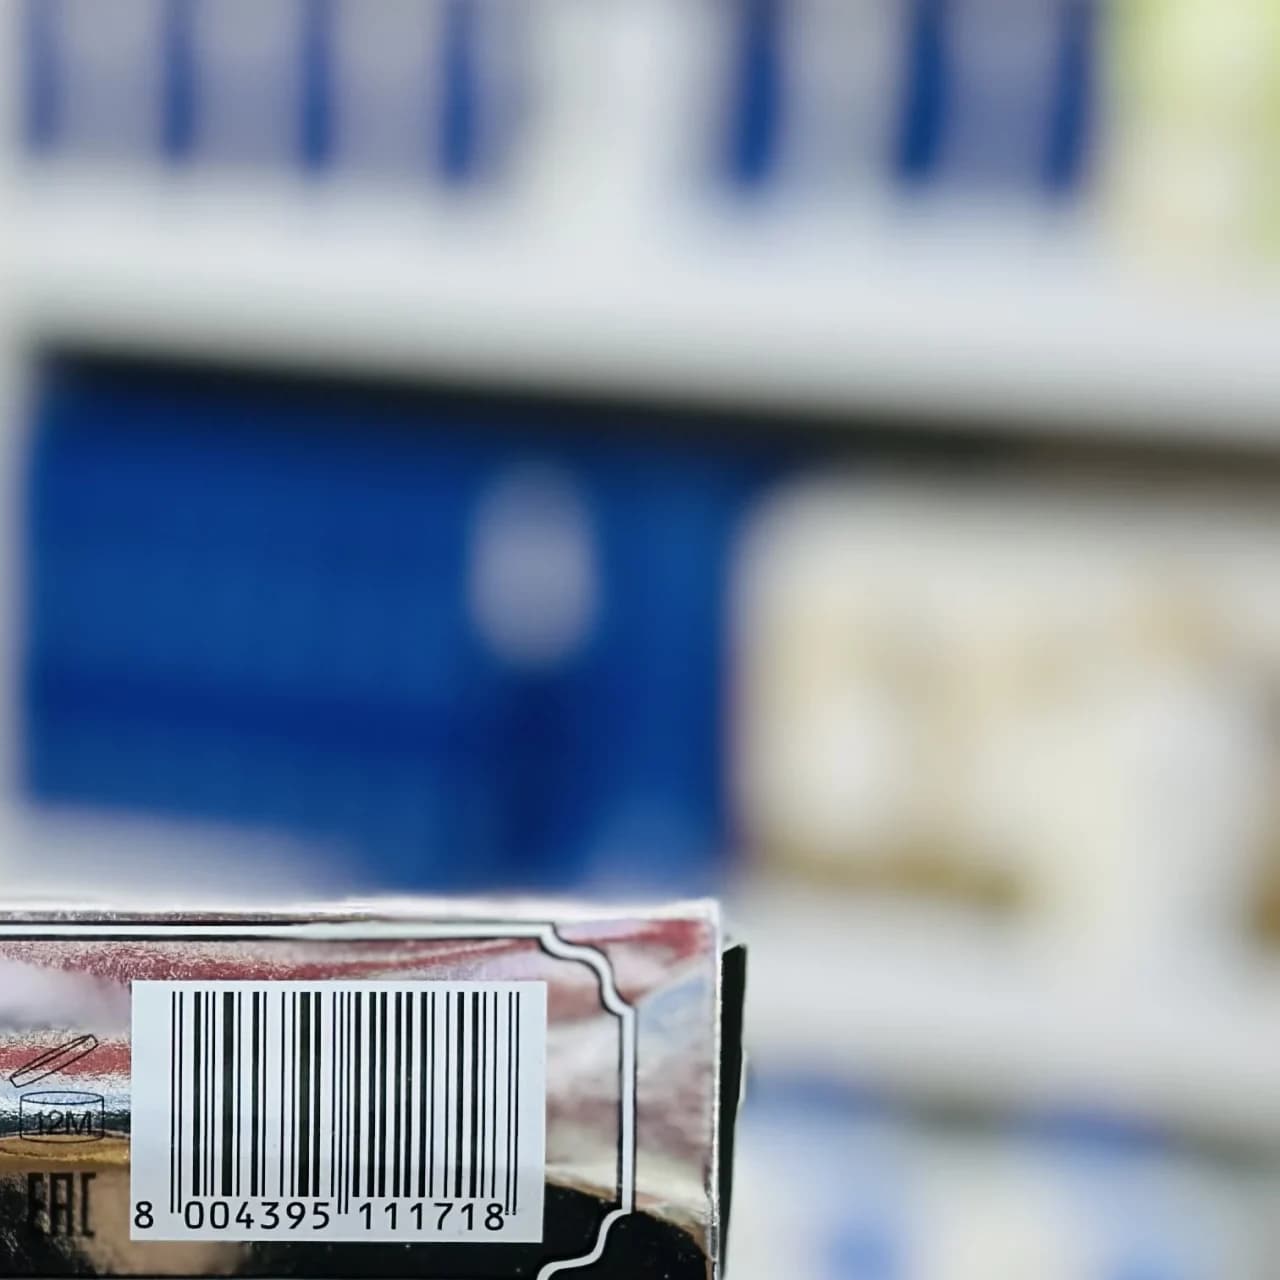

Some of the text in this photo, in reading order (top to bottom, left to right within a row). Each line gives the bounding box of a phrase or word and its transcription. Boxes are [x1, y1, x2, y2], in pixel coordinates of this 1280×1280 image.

[36, 1110, 93, 1136] 12M
[134, 1201, 504, 1231] 8 004395 111718
